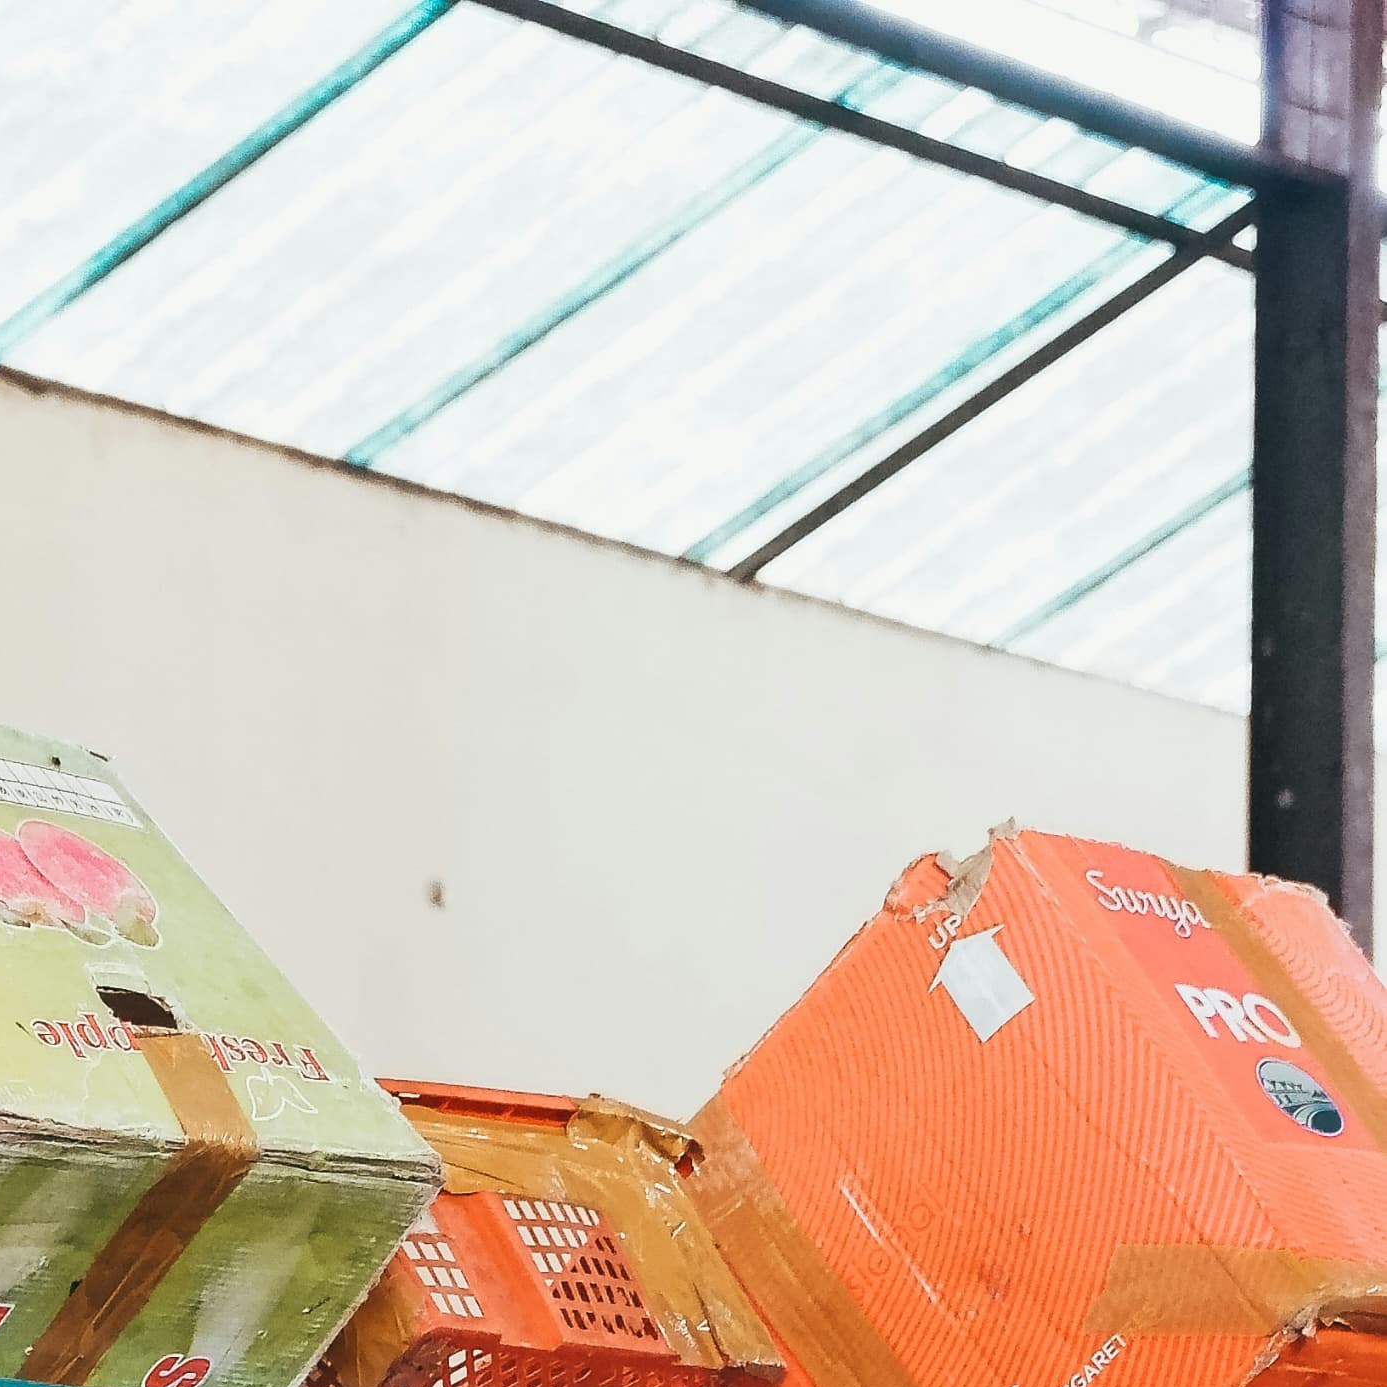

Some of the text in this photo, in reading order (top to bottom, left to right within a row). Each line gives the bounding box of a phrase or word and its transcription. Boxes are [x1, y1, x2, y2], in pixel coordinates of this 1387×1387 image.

[926, 912, 964, 951] UP
[1085, 869, 1214, 938] Surya
[32, 1012, 144, 1058] pple
[1174, 983, 1302, 1049] PRO
